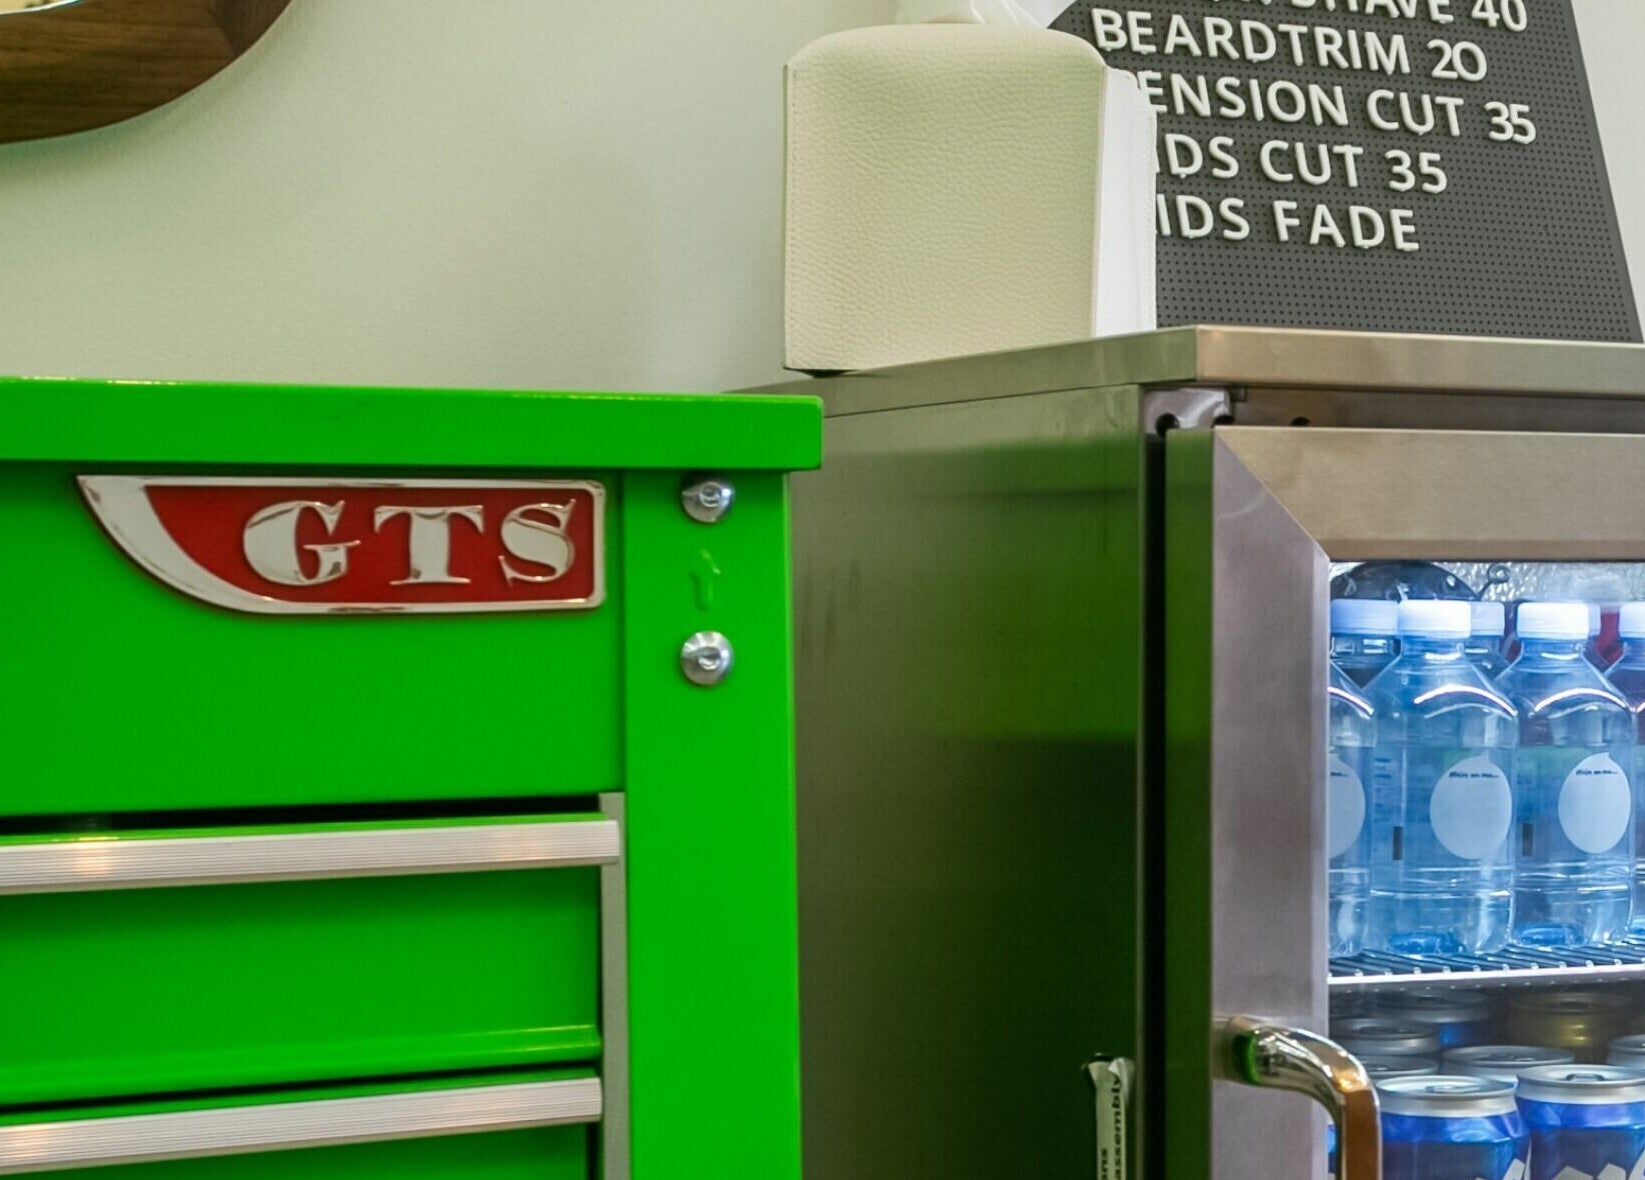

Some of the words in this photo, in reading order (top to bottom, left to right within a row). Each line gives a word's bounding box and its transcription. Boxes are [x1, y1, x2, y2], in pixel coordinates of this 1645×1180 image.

[1091, 8, 1411, 76] BEARDTRIM
[1426, 39, 1488, 82] 20
[1137, 69, 1349, 128] ENSION
[1366, 89, 1465, 136] CUT
[1484, 101, 1537, 145] 35
[1155, 133, 1240, 179] DS
[1259, 139, 1364, 188] CUT
[1384, 149, 1448, 194] 35
[1155, 193, 1251, 241] IDS
[1273, 200, 1420, 251] FADE
[242, 497, 579, 588] GTS
